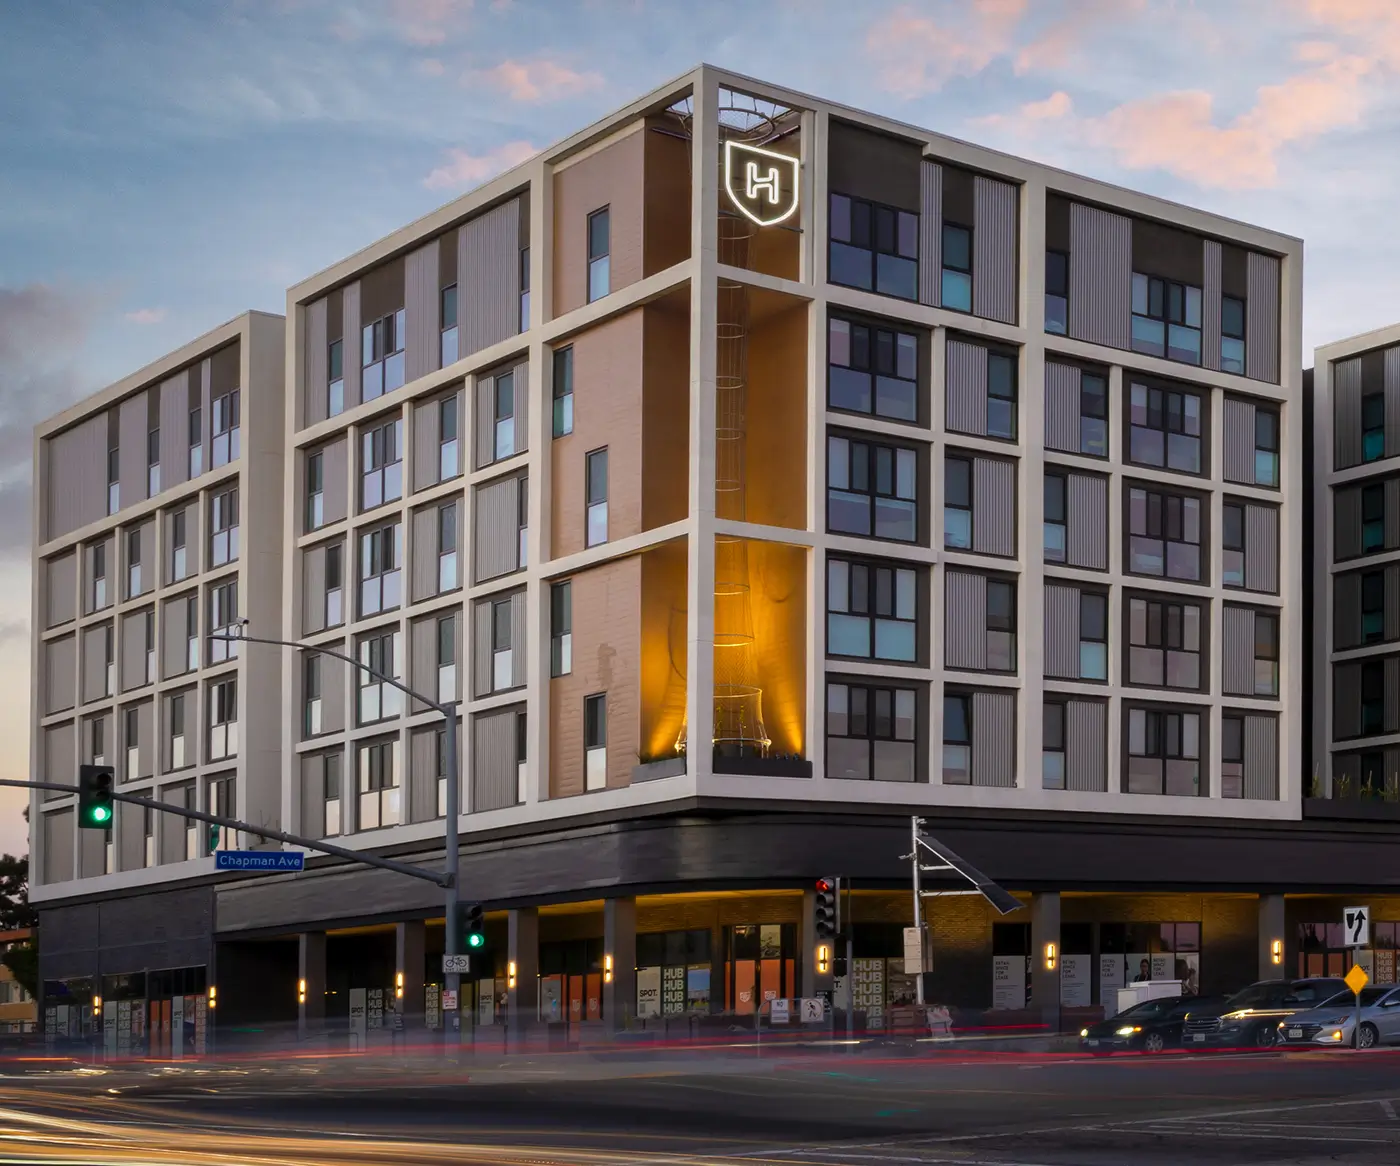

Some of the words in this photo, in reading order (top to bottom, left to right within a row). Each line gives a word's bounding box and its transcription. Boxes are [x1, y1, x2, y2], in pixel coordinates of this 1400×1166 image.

[746, 162, 779, 204] H
[219, 855, 275, 868] Chapman
[278, 856, 300, 866] Ave
[852, 960, 882, 971] HUB
[664, 968, 684, 979] HUB
[852, 971, 882, 982] HUB
[664, 980, 684, 991] HUB
[852, 983, 882, 994] HUB
[664, 991, 684, 1002] HUB
[852, 995, 882, 1006] HUB
[664, 1003, 684, 1013] HUB
